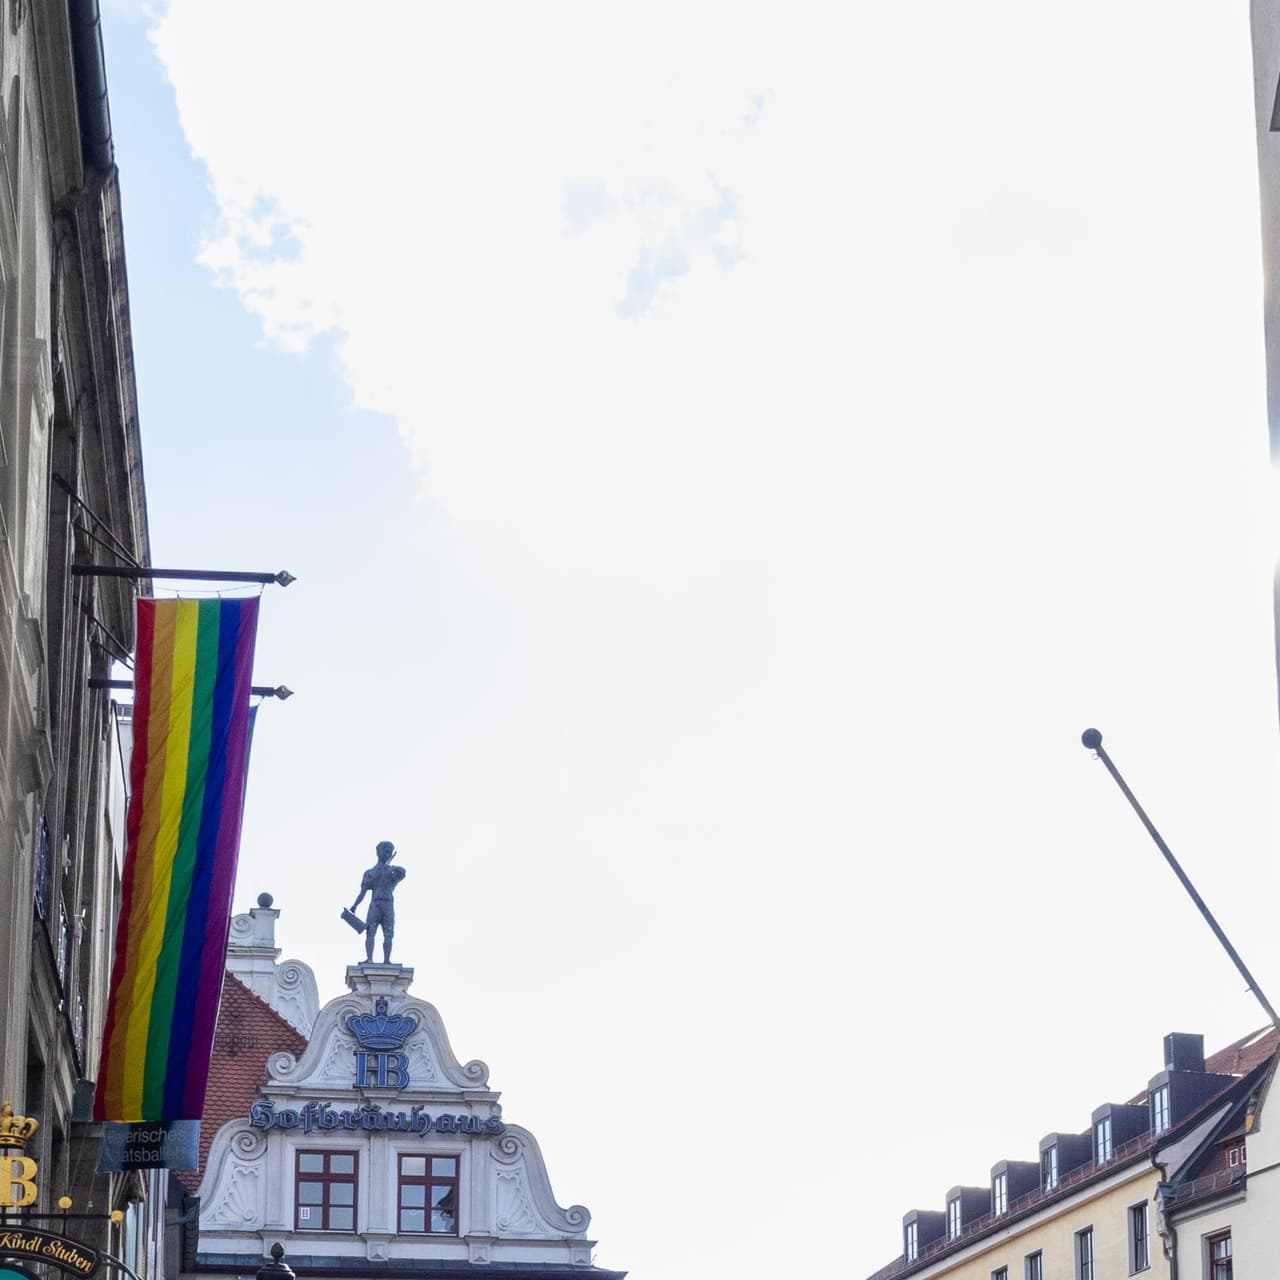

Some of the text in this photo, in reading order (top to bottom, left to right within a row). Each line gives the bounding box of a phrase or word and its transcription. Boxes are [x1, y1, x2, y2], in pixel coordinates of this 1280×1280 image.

[353, 1050, 410, 1090] HB
[249, 1100, 507, 1138] Hofbräuhaus
[42, 1239, 93, 1273] Stuben
